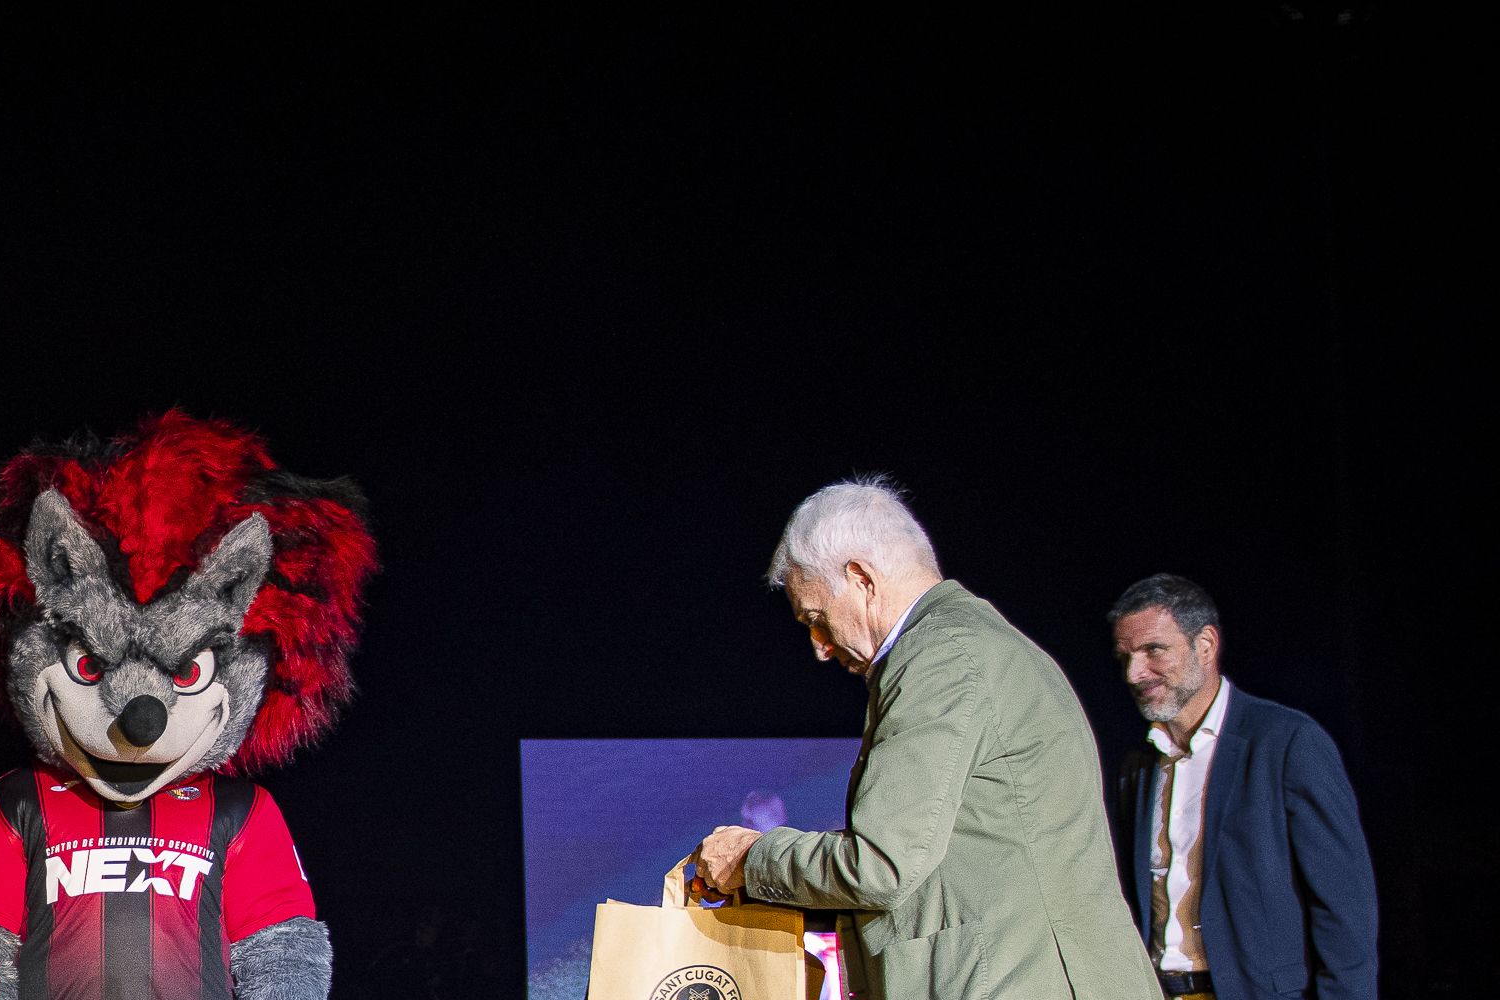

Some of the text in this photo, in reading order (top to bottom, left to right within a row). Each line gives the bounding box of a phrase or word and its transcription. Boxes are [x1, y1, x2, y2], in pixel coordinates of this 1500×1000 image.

[46, 840, 78, 857] CENTRO
[82, 838, 94, 847] DE
[168, 840, 215, 860] DEPORTIVO
[45, 847, 213, 905] NEXT
[685, 970, 730, 988] CUGAT
